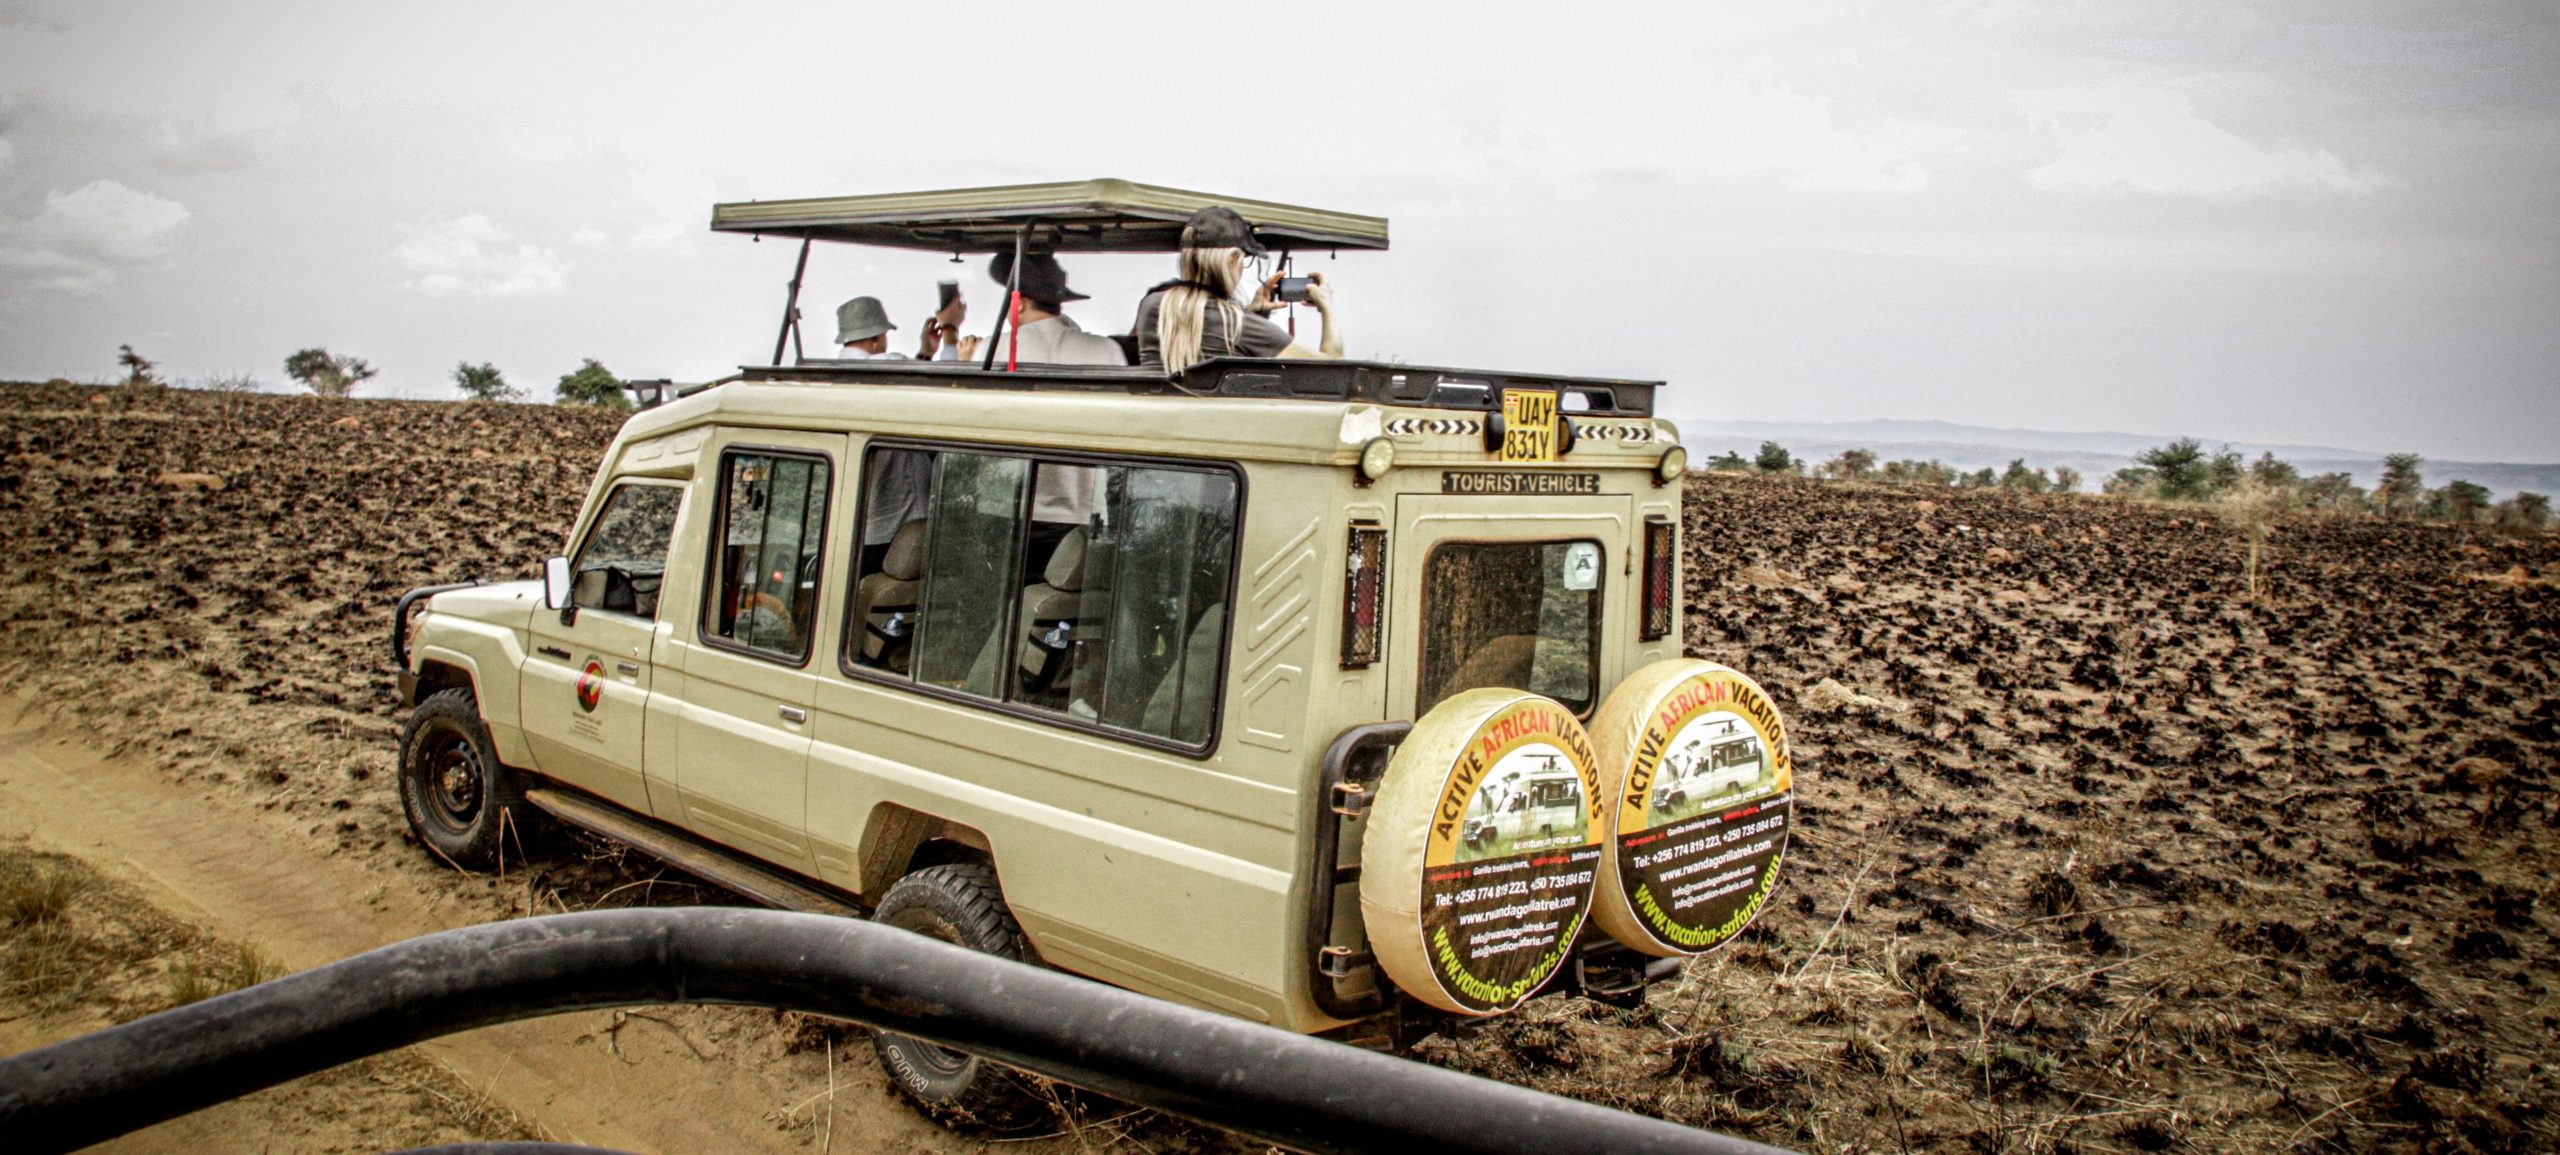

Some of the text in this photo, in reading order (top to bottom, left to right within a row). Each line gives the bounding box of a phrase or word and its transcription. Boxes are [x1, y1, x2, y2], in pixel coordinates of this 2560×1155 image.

[1519, 396, 1553, 426] UAY
[1506, 430, 1550, 460] 831Y
[1449, 473, 1594, 492] TOURIST VEHICLE
[1575, 557, 1592, 571] A
[1626, 681, 1789, 811] ACTIVE AFRICAN VACATIONS
[1436, 708, 1604, 841] ACTIVE AFRICAN VACATIONS
[1634, 854, 1651, 869] Tel:
[1652, 848, 1673, 863] +256
[1674, 844, 1689, 859] 774
[1690, 840, 1704, 854] 819
[1722, 829, 1741, 844] +250
[1742, 825, 1755, 839] 735
[1769, 815, 1783, 828] 672
[1659, 840, 1772, 882] www.rwandagorillatrek.com
[1435, 893, 1453, 907] Tel:
[1455, 889, 1476, 904] +256
[1477, 887, 1493, 900] 774
[1509, 881, 1529, 895] 223,
[1549, 874, 1565, 889] 735
[1578, 870, 1593, 884] 672
[1634, 854, 1781, 946] www.vacation-safaris.com
[887, 1044, 929, 1093] MUD
